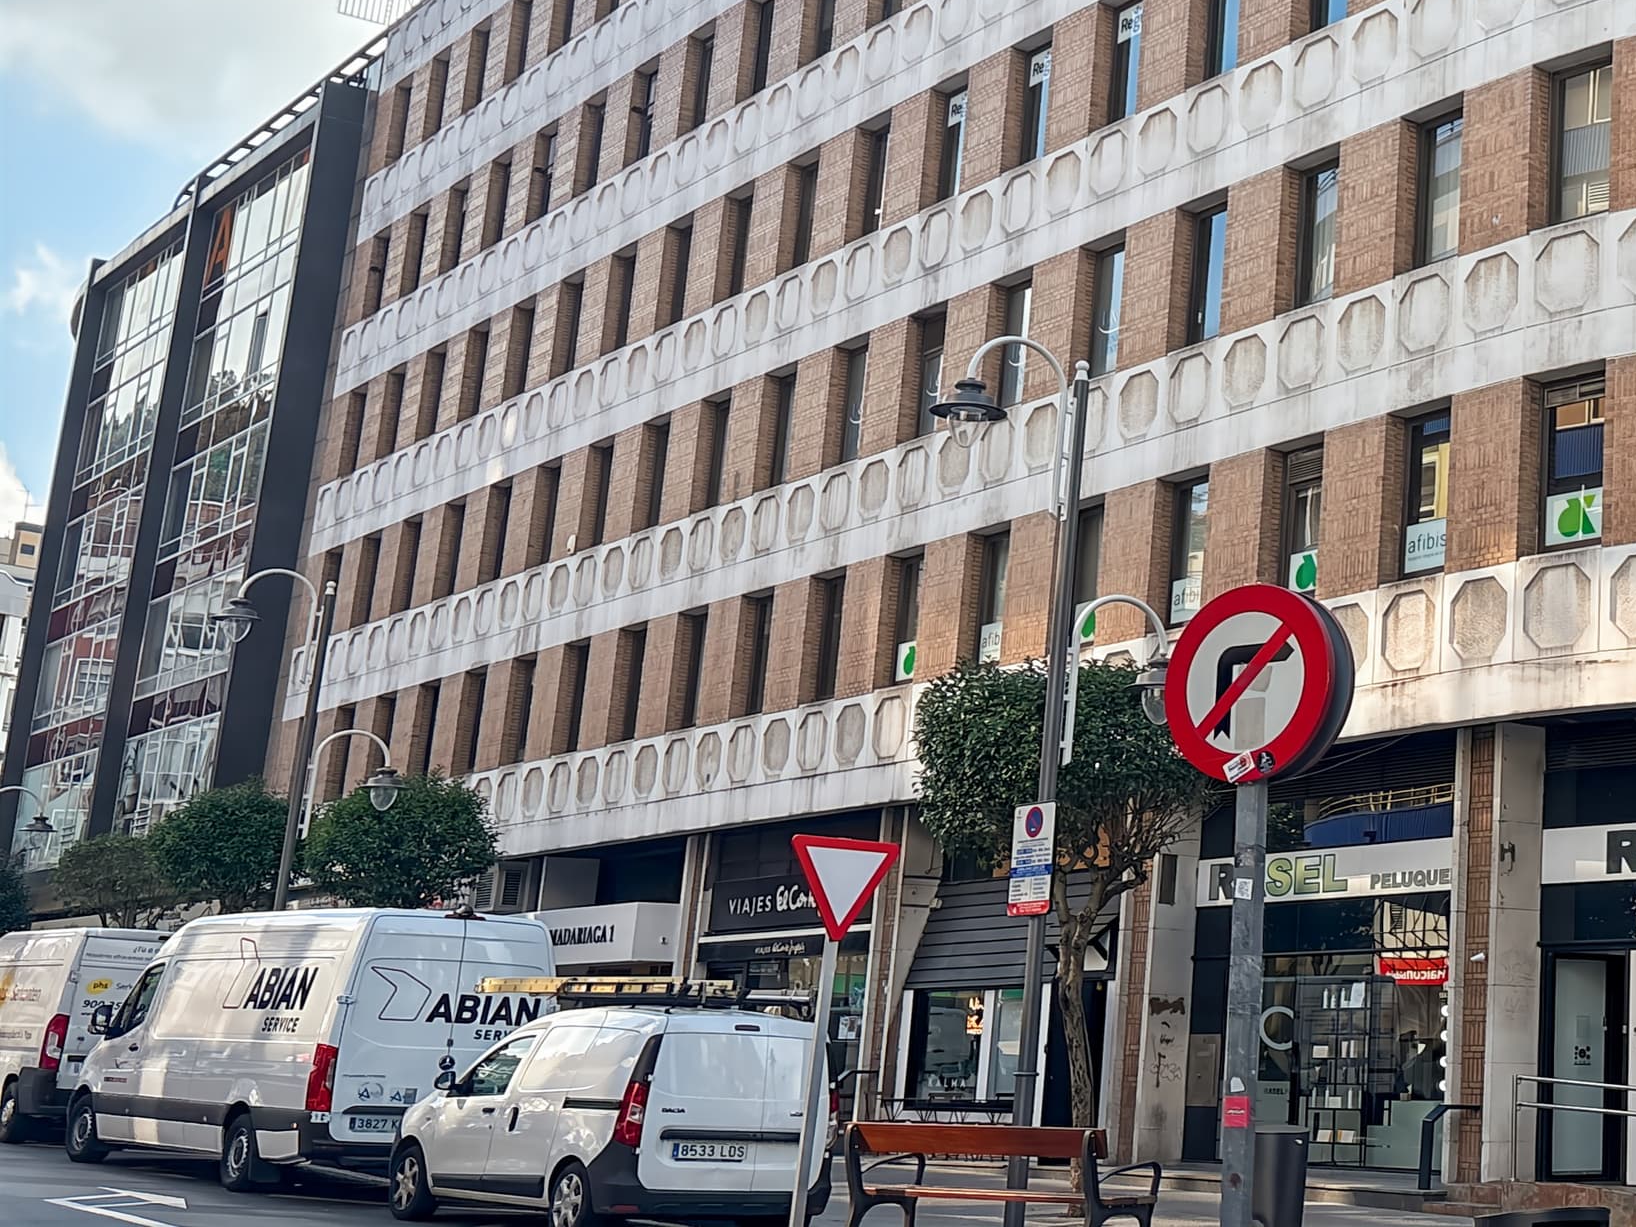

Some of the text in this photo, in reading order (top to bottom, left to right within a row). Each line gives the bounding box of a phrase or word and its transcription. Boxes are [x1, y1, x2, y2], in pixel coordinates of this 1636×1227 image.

[1208, 853, 1348, 901] RSEL
[728, 895, 772, 917] VIAJES
[609, 924, 615, 943] 1
[244, 966, 320, 1011] ABIAN
[425, 993, 541, 1027] ABIAN
[261, 1017, 300, 1034] SERVICE
[357, 1118, 388, 1130] 3827
[680, 1144, 715, 1157] 8533
